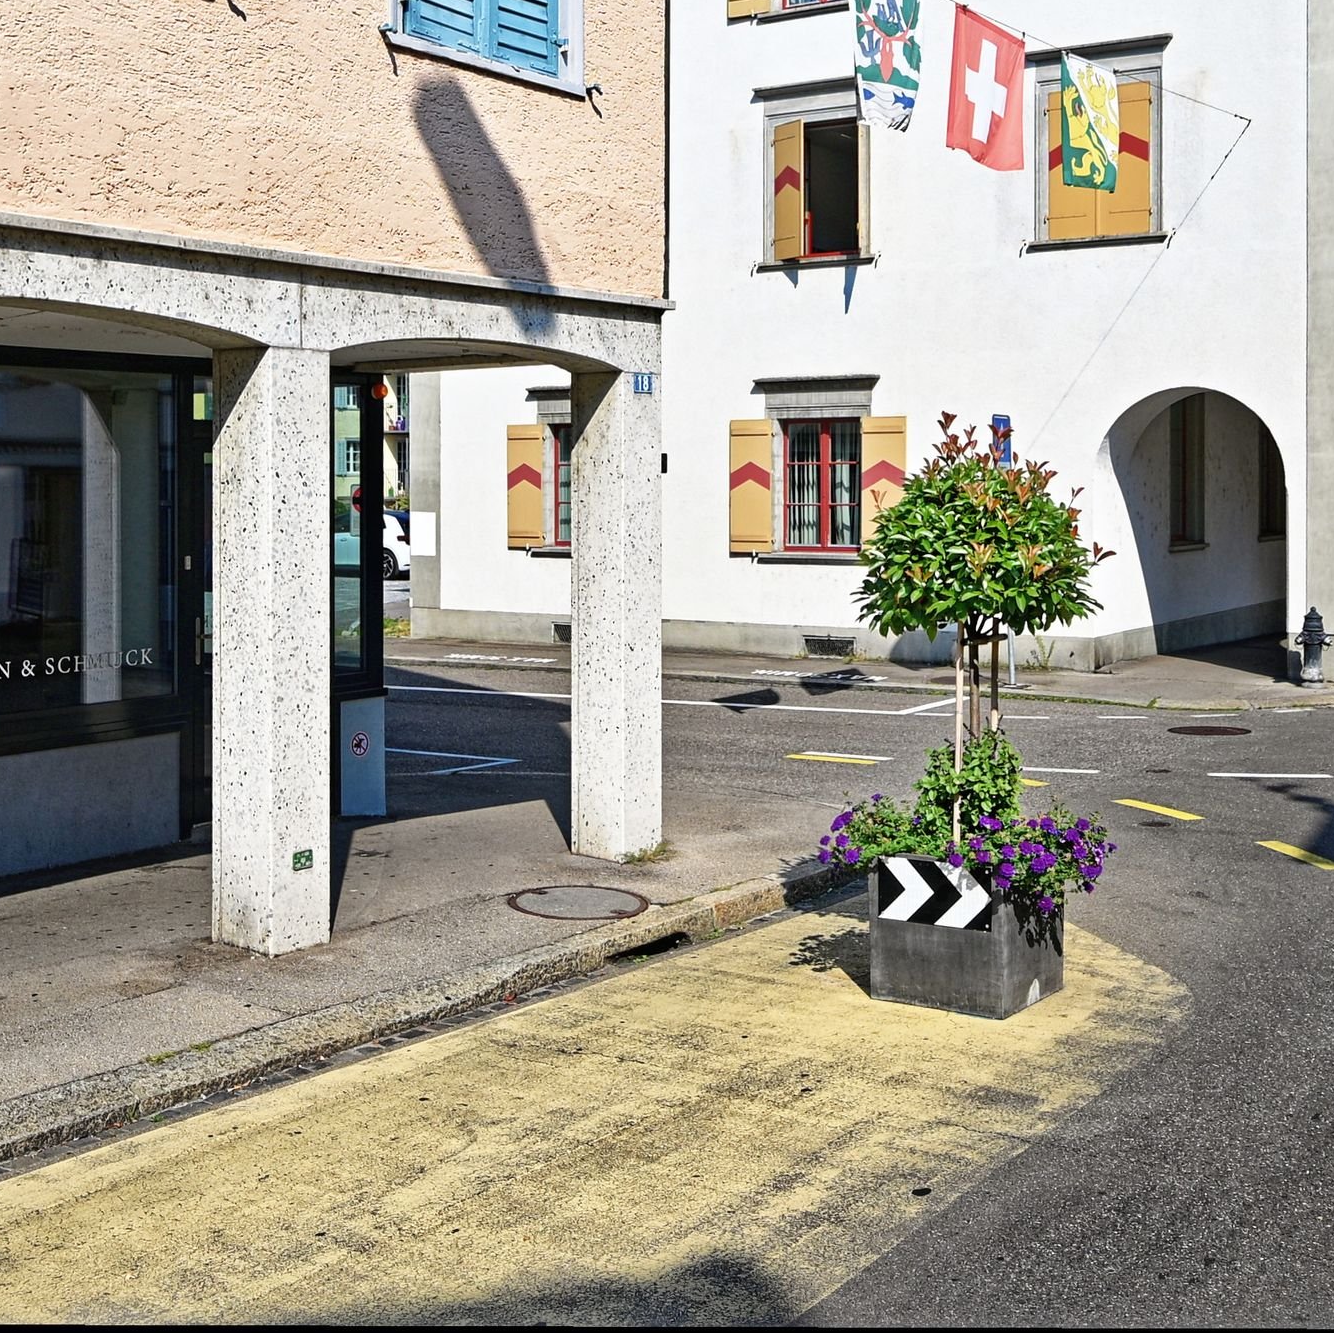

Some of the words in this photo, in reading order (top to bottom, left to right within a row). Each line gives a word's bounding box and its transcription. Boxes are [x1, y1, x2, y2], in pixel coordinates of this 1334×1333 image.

[637, 375, 649, 391] 18
[21, 659, 36, 677] &
[45, 647, 154, 676] SCHMUCK
